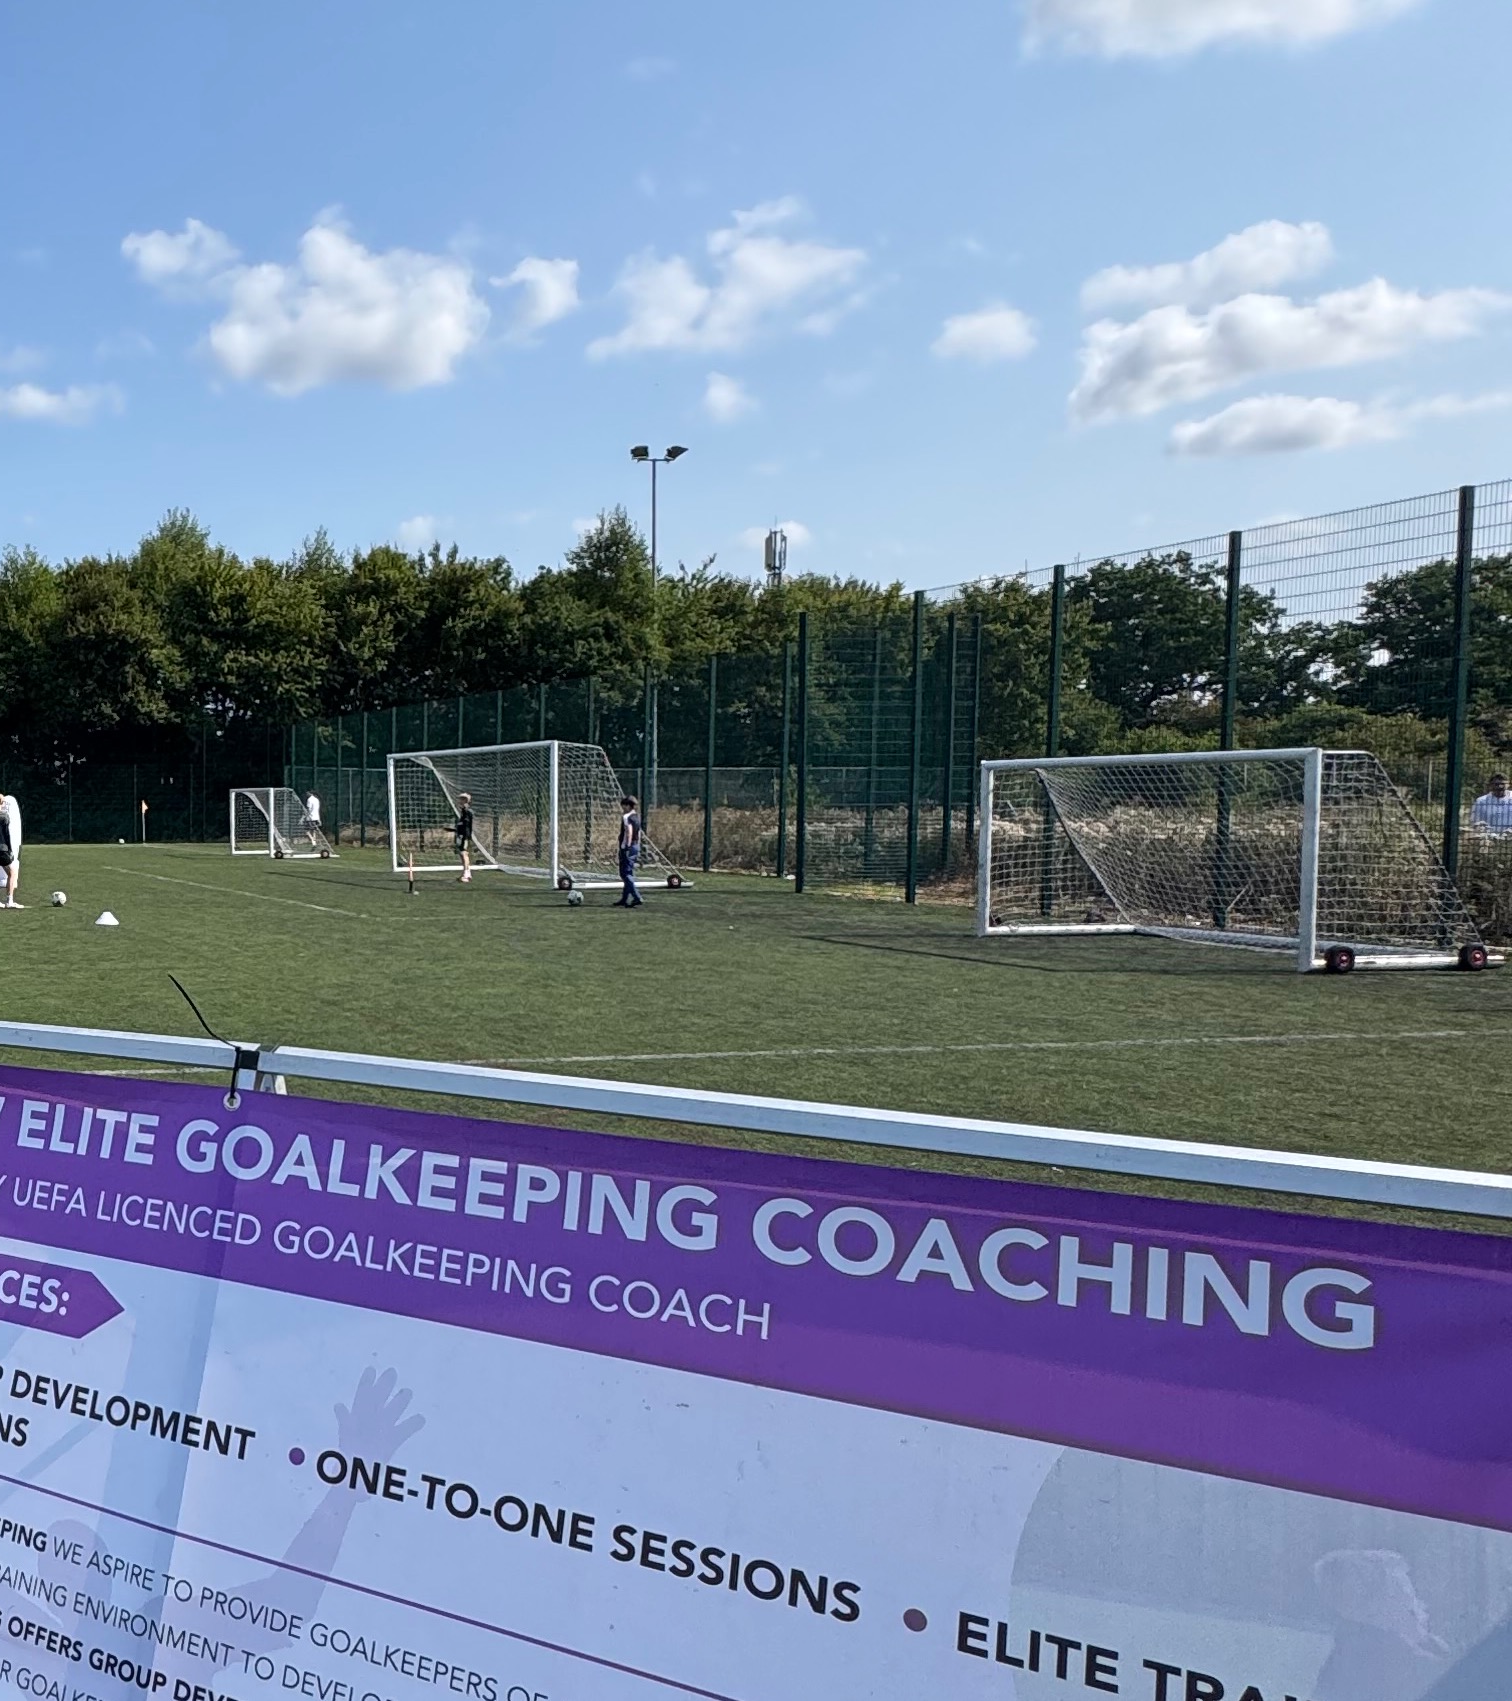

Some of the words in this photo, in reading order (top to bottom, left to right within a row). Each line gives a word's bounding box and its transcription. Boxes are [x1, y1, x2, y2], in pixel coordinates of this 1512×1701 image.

[12, 1175, 88, 1218] UEFA
[96, 1193, 261, 1246] LICENCED
[273, 1221, 572, 1305] GOALKEEPING
[587, 1276, 771, 1340] COACH
[18, 1101, 158, 1166] ELITE
[176, 1119, 718, 1252] GOALKEEPING
[752, 1198, 1375, 1350] COACHING
[10, 1369, 256, 1460] DEVELOPMENT
[316, 1450, 595, 1553] ONE-TO-ONE
[610, 1524, 861, 1623] SESSIONS
[7, 1616, 83, 1662] OFFERS
[88, 1648, 167, 1693] GROUP
[173, 1679, 240, 1701] DEV
[53, 1537, 84, 1565] WE
[86, 1550, 155, 1592] ASPIRE
[161, 1574, 193, 1602] TO
[199, 1587, 303, 1639] PROVIDE
[310, 1623, 498, 1701] GOALKEEPERS
[73, 1592, 235, 1666] ENVIRONMENT
[241, 1650, 274, 1680] TO
[282, 1665, 394, 1701] DEVEL
[956, 1611, 1119, 1694] ELITE
[16, 1667, 103, 1701] GOALK
